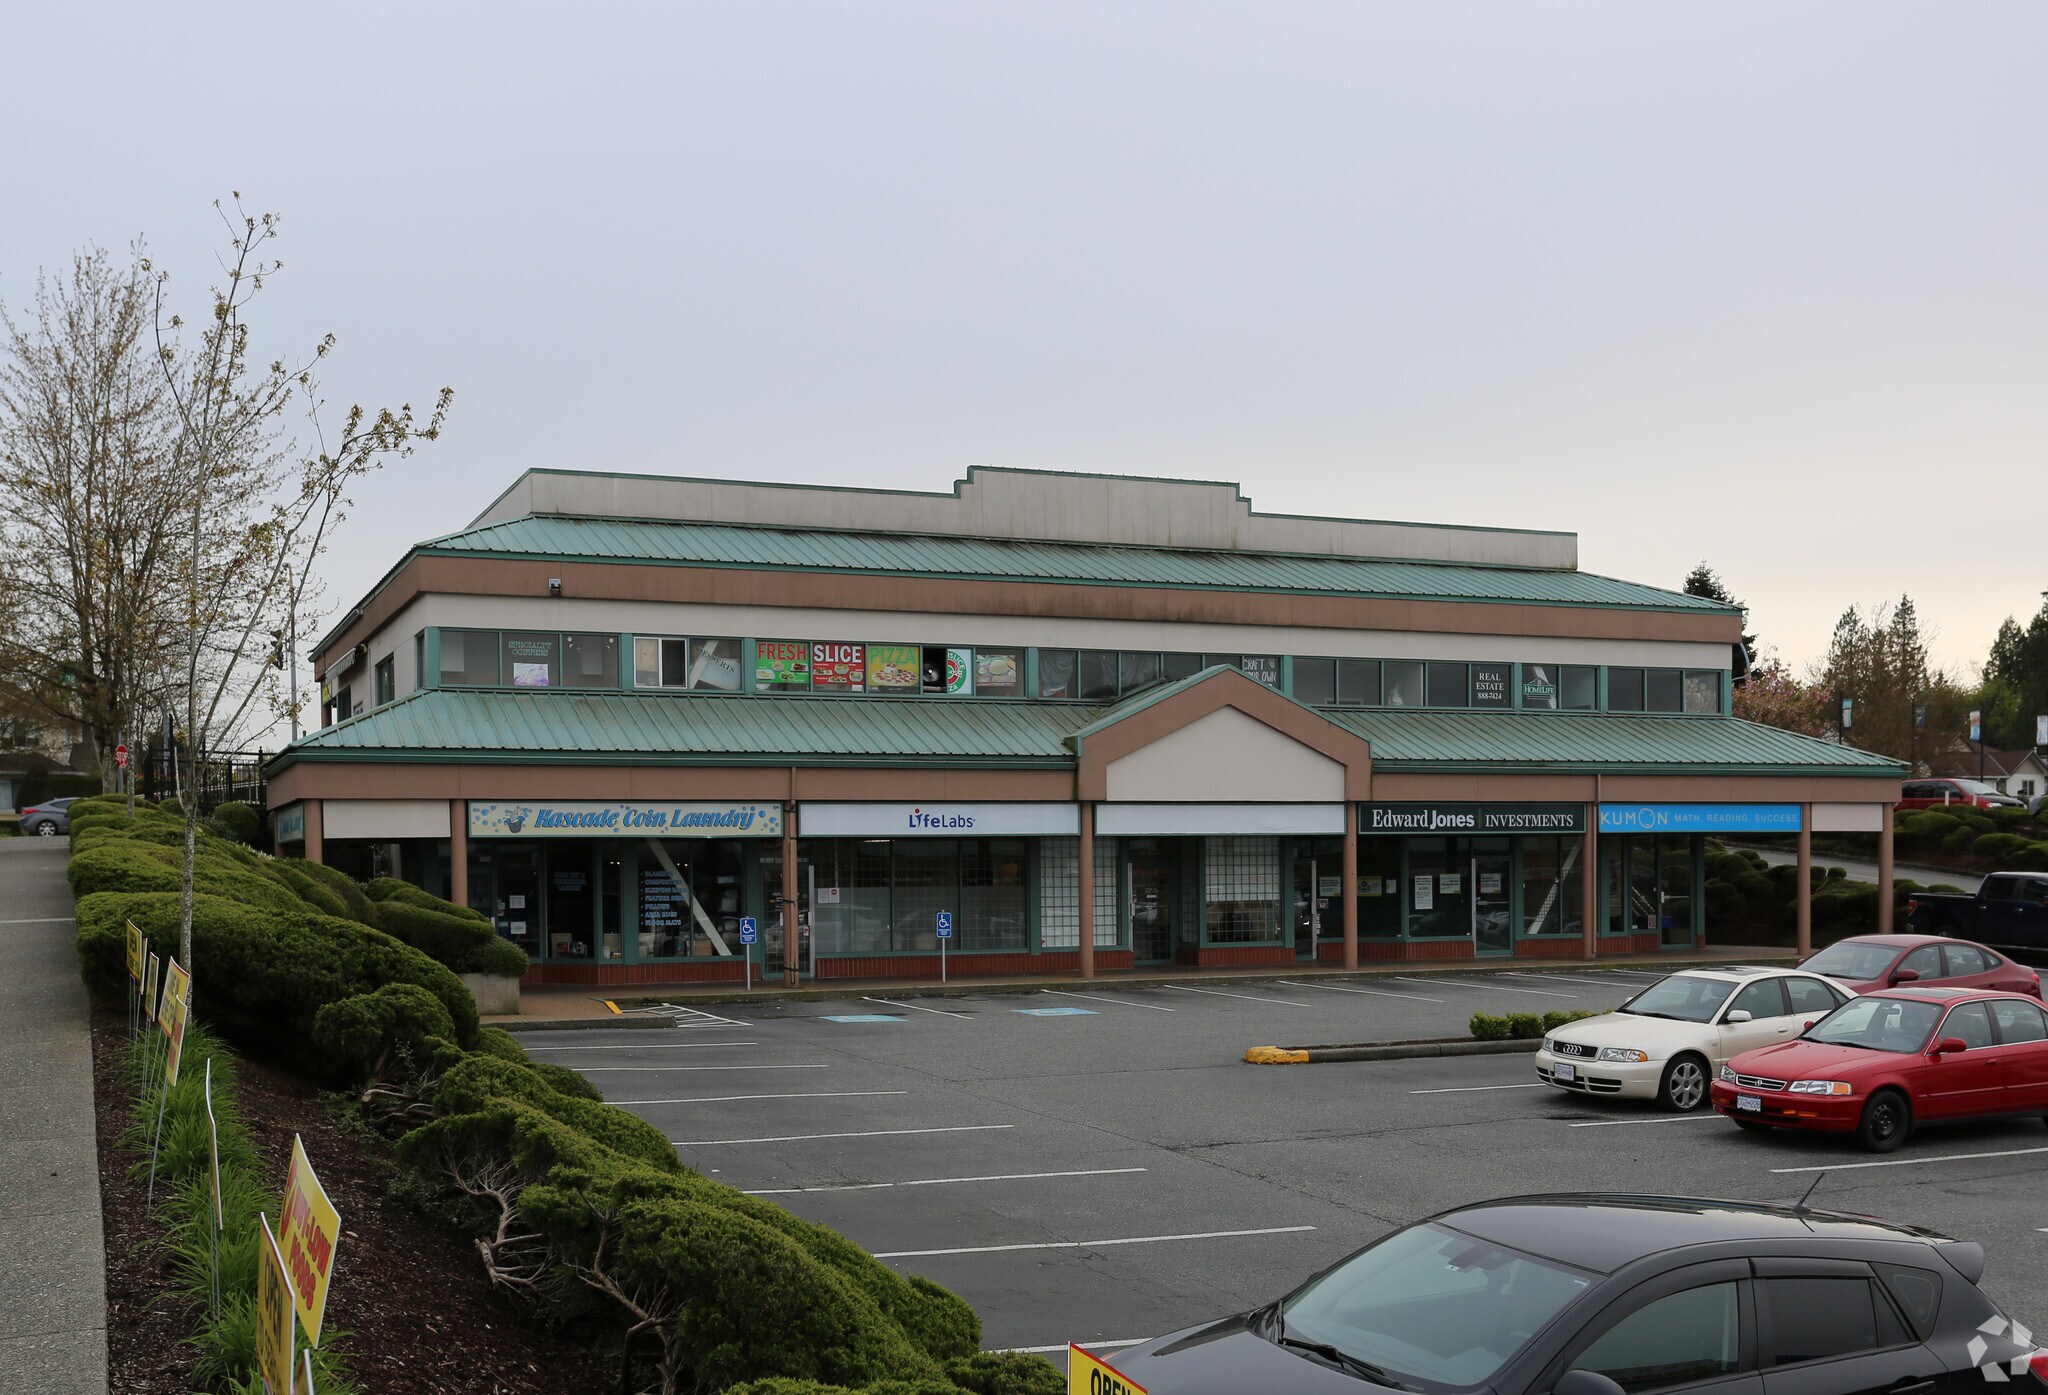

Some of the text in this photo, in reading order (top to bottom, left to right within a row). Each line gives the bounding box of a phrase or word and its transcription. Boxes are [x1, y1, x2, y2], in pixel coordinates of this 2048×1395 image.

[757, 643, 807, 660] FRESH
[813, 644, 863, 663] SLICE
[870, 646, 917, 665] PIZZA
[1243, 658, 1265, 670] CRAFT
[1261, 671, 1277, 682] OWN
[1476, 682, 1504, 690] ESTATE
[1479, 672, 1501, 681] REAL
[116, 752, 128, 760] STOP
[534, 808, 756, 830] Kascade Coin Laundry
[909, 808, 975, 828] LifeLabs
[1485, 813, 1574, 828] INVESTMENTS
[1600, 808, 1669, 829] KUMON
[289, 1231, 316, 1311] FOODS
[265, 1251, 283, 1354] OPEN
[1091, 1368, 1131, 1395] OPE
